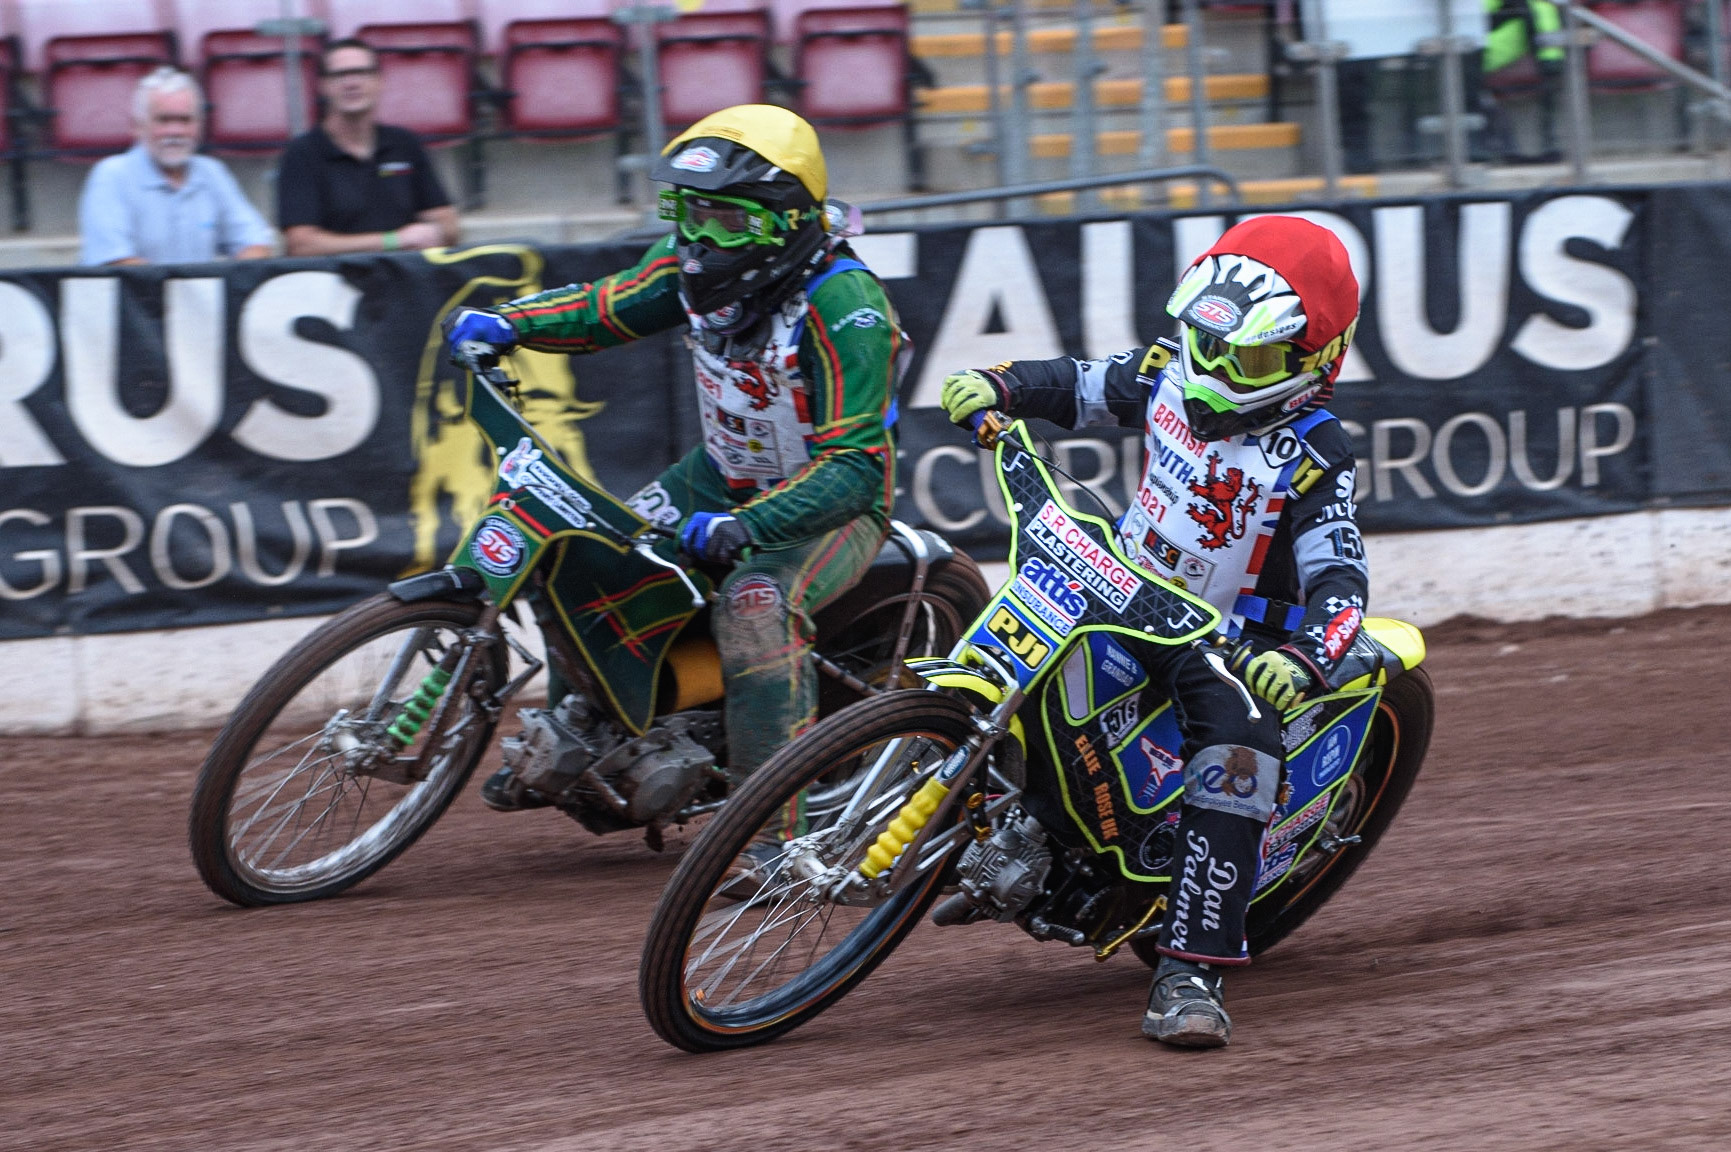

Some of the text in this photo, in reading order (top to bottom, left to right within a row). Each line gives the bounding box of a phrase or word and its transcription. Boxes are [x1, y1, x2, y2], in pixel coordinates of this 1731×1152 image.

[1193, 301, 1234, 323] STS
[1266, 432, 1297, 460] 10
[1291, 456, 1325, 495] J1
[477, 529, 518, 563] STS
[1029, 519, 1126, 608] PLASTERING
[1063, 527, 1138, 597] CHARGE
[987, 607, 1050, 669] PJ1
[1012, 581, 1074, 637] INSURANCE
[1074, 734, 1102, 776] ELLIE
[1093, 781, 1116, 820] ROSE
[1170, 829, 1210, 952] Palmer
[1202, 857, 1238, 932] Dan
